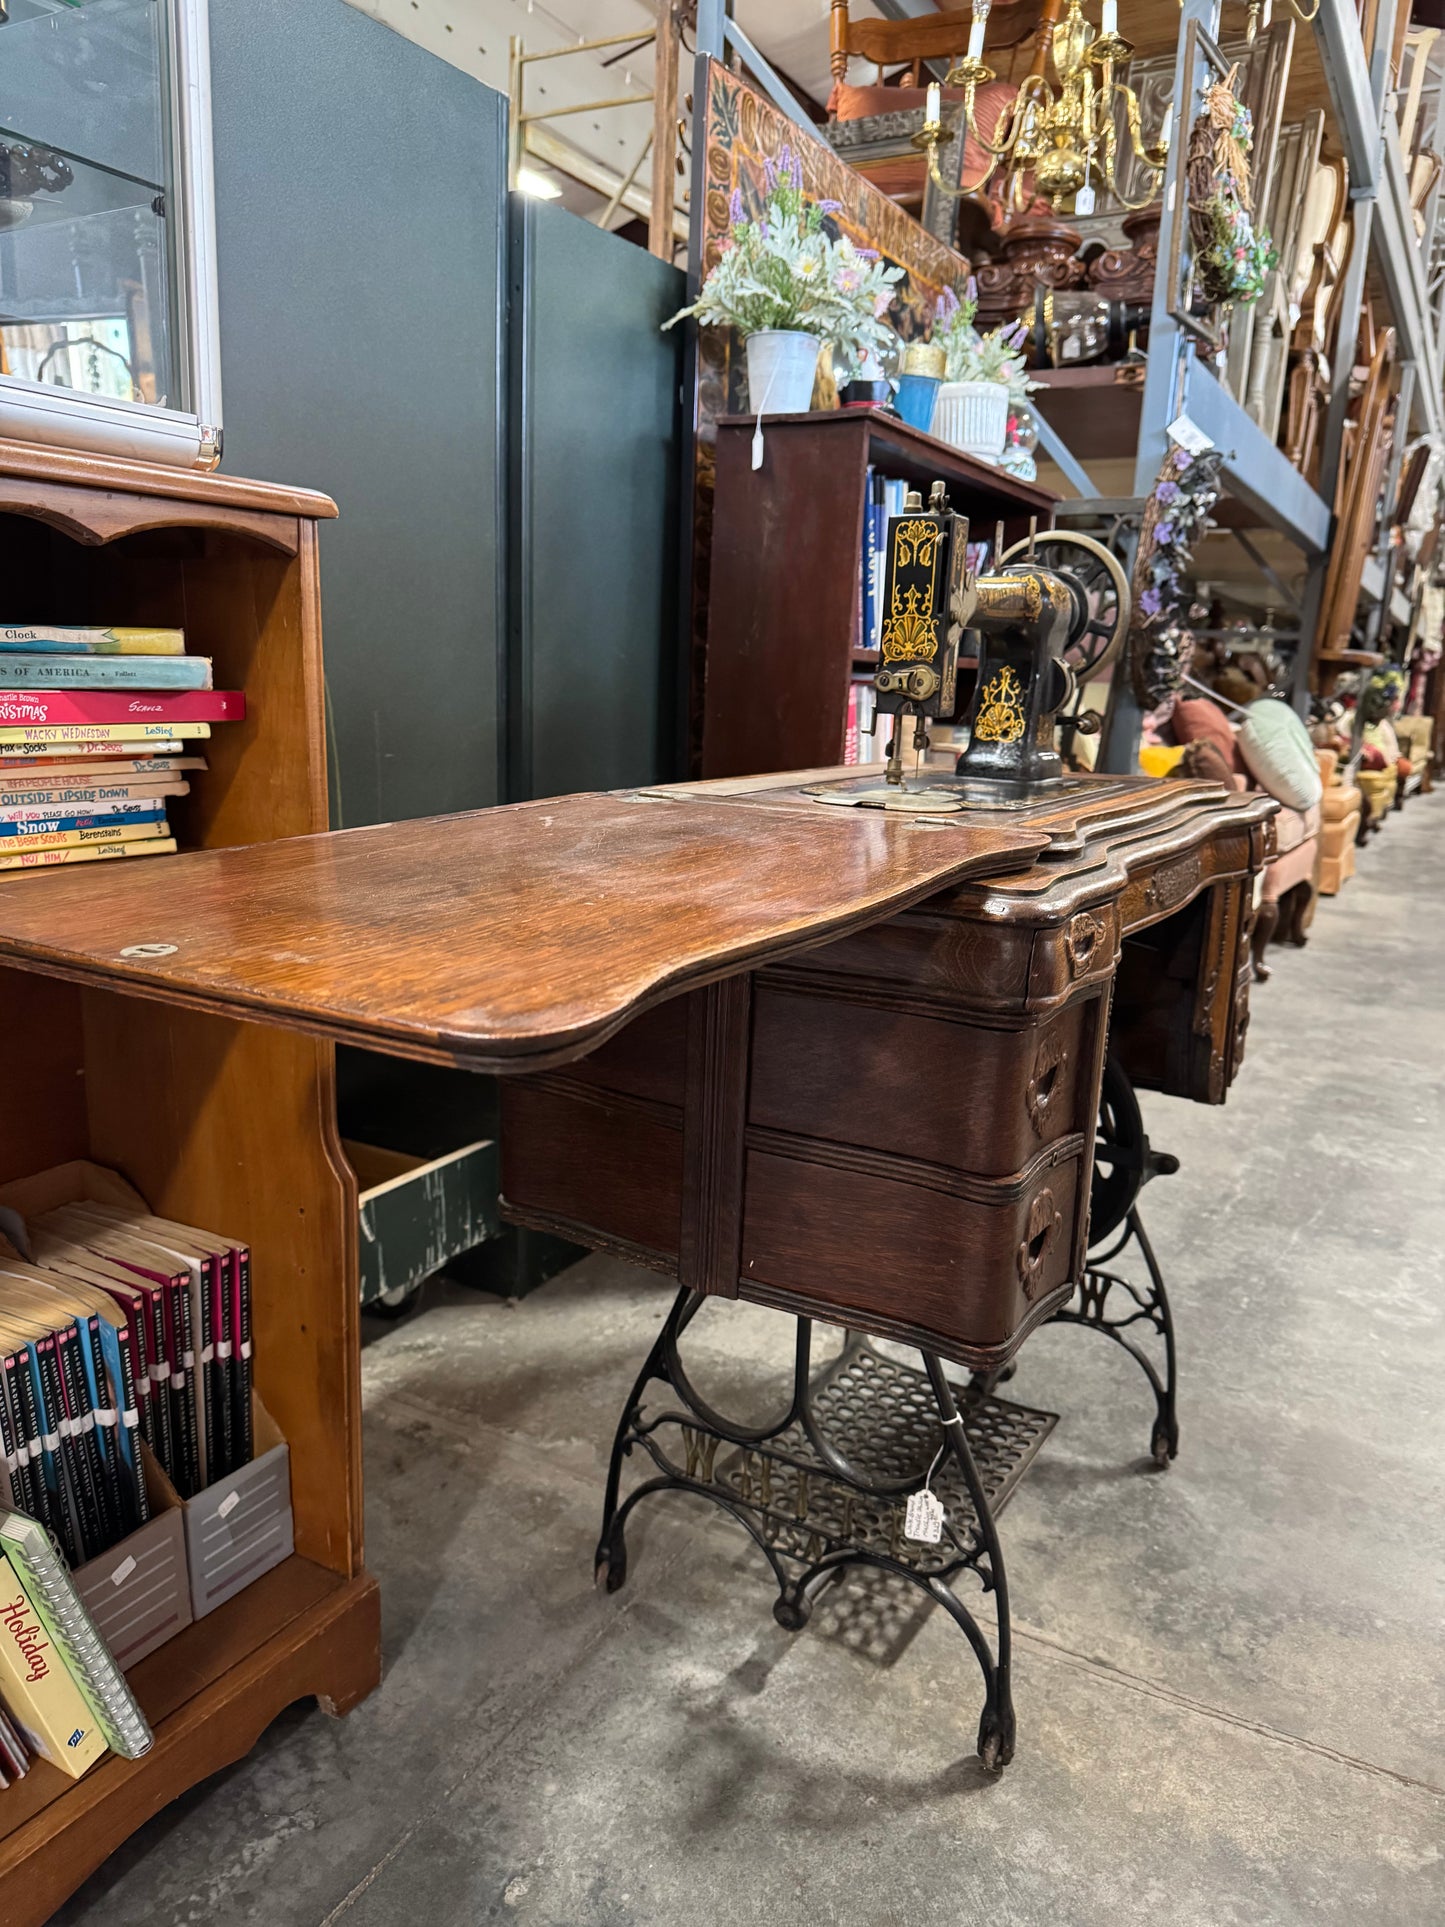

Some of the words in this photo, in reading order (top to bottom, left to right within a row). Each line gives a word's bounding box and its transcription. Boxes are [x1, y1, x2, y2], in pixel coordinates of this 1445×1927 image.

[5, 629, 37, 639] Clock
[15, 667, 31, 676] OF
[37, 667, 90, 677] AMERICA
[61, 727, 111, 739] WEDNESDAY
[144, 725, 174, 737] LeSieg
[101, 740, 124, 753] Seuss
[26, 776, 61, 787] PEOPLE
[62, 775, 94, 786] HOUSE
[146, 760, 170, 771] Seuss
[1, 791, 54, 806] OUTSIDE
[58, 789, 97, 801] UPSIDE
[98, 788, 129, 799] DOWN
[42, 809, 63, 819] PLEASE
[64, 809, 76, 818] GO
[16, 820, 60, 835] Snow
[16, 835, 39, 848] Bear
[79, 828, 122, 840] Berenstains
[20, 853, 39, 867] NOT
[172, 1294, 181, 1333] READER'S
[182, 1292, 190, 1327] READER'S
[202, 1278, 210, 1318] READER'S
[154, 1308, 162, 1343] READER'S
[92, 1337, 103, 1378] READER'S
[123, 1347, 133, 1384] READER'S
[40, 1359, 52, 1400] READER'S
[71, 1344, 85, 1386] READER'S
[79, 1387, 89, 1413] DIGES
[135, 1317, 145, 1352] READER'S
[144, 1415, 153, 1441] PEOPLE
[127, 1385, 136, 1408] DIGES
[8, 1375, 21, 1419] READER'S
[15, 1421, 25, 1448] DIGES
[22, 1467, 33, 1499] ECRETS
[24, 1370, 35, 1410] READER'S
[35, 1454, 47, 1491] FUNNIEST
[49, 1356, 62, 1393] READER'S
[56, 1394, 66, 1417] DIGES
[66, 1445, 79, 1485] SOLUTIONS
[62, 1350, 73, 1386] READER'S
[68, 1387, 77, 1414] DIGEST
[80, 1463, 92, 1497] AMERICA
[4, 1429, 13, 1454] DIGES
[131, 1431, 141, 1463] SECRETS
[135, 1463, 145, 1502] HOSPITALS
[0, 1594, 50, 1682] Holiday
